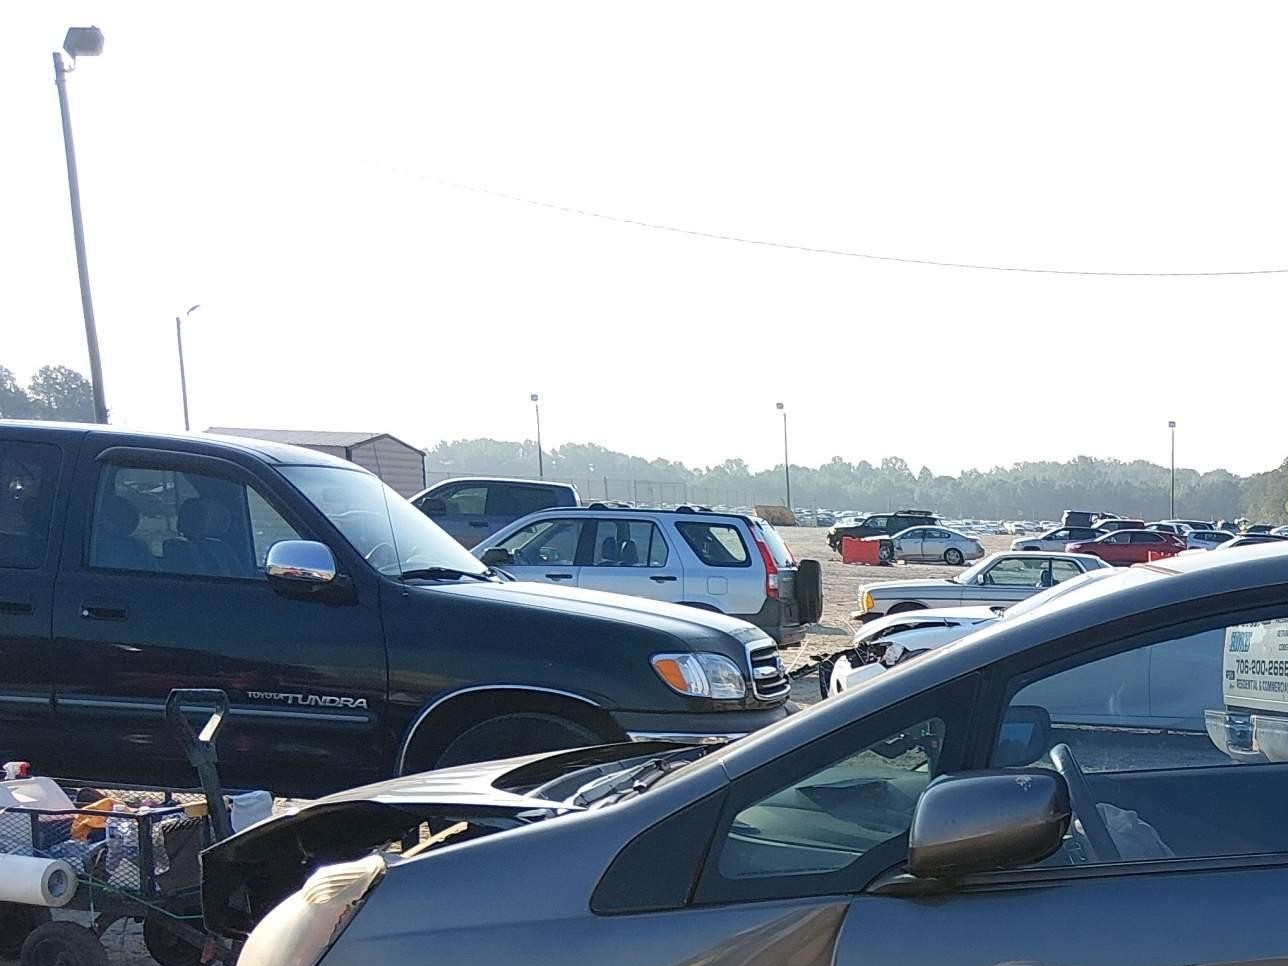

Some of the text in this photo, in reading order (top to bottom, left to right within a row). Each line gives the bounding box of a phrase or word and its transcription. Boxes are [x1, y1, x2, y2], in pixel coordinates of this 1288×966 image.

[1236, 678, 1258, 691] RESIDENTIAL
[247, 691, 368, 709] TOYOTA TUNDRA
